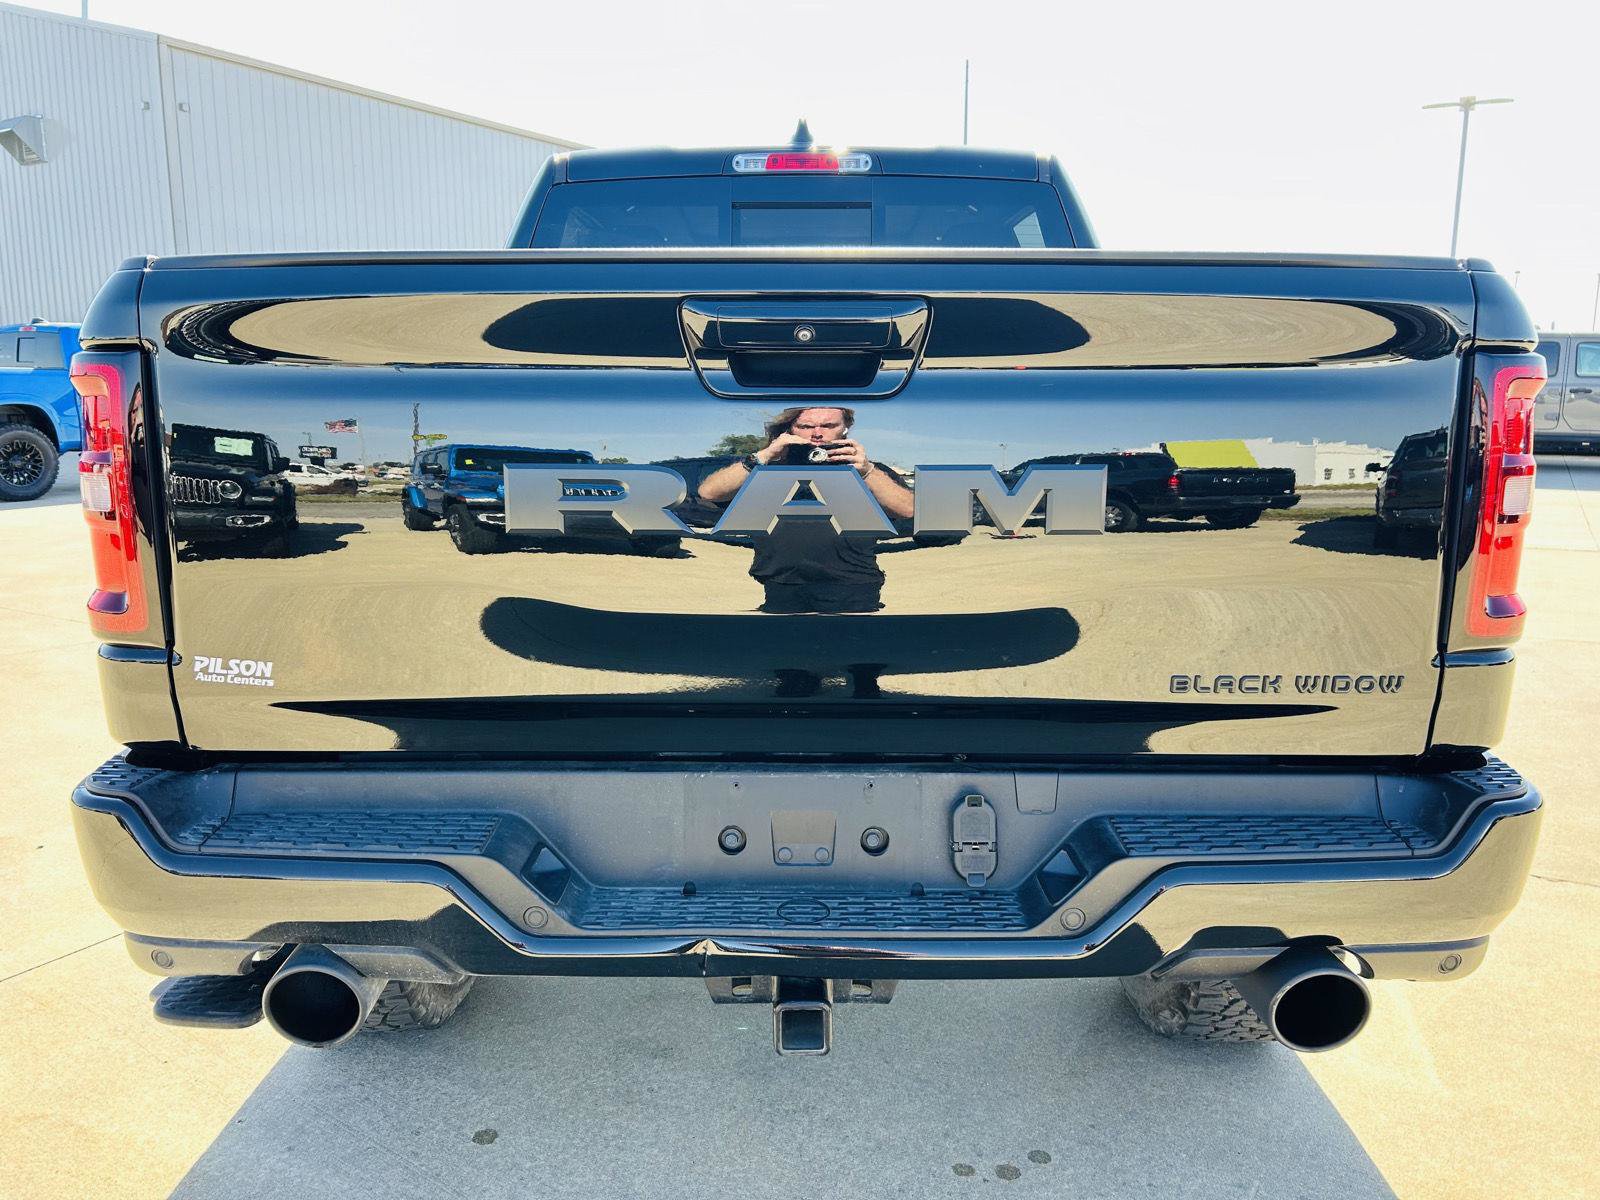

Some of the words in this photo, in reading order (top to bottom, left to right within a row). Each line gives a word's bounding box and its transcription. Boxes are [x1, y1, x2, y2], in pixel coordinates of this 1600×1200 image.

[503, 463, 1107, 536] RAM
[193, 655, 273, 677] PILSON
[195, 672, 225, 683] Auto
[227, 674, 274, 686] Centers
[1169, 674, 1283, 694] BLACK
[1295, 674, 1405, 694] WIDOW
